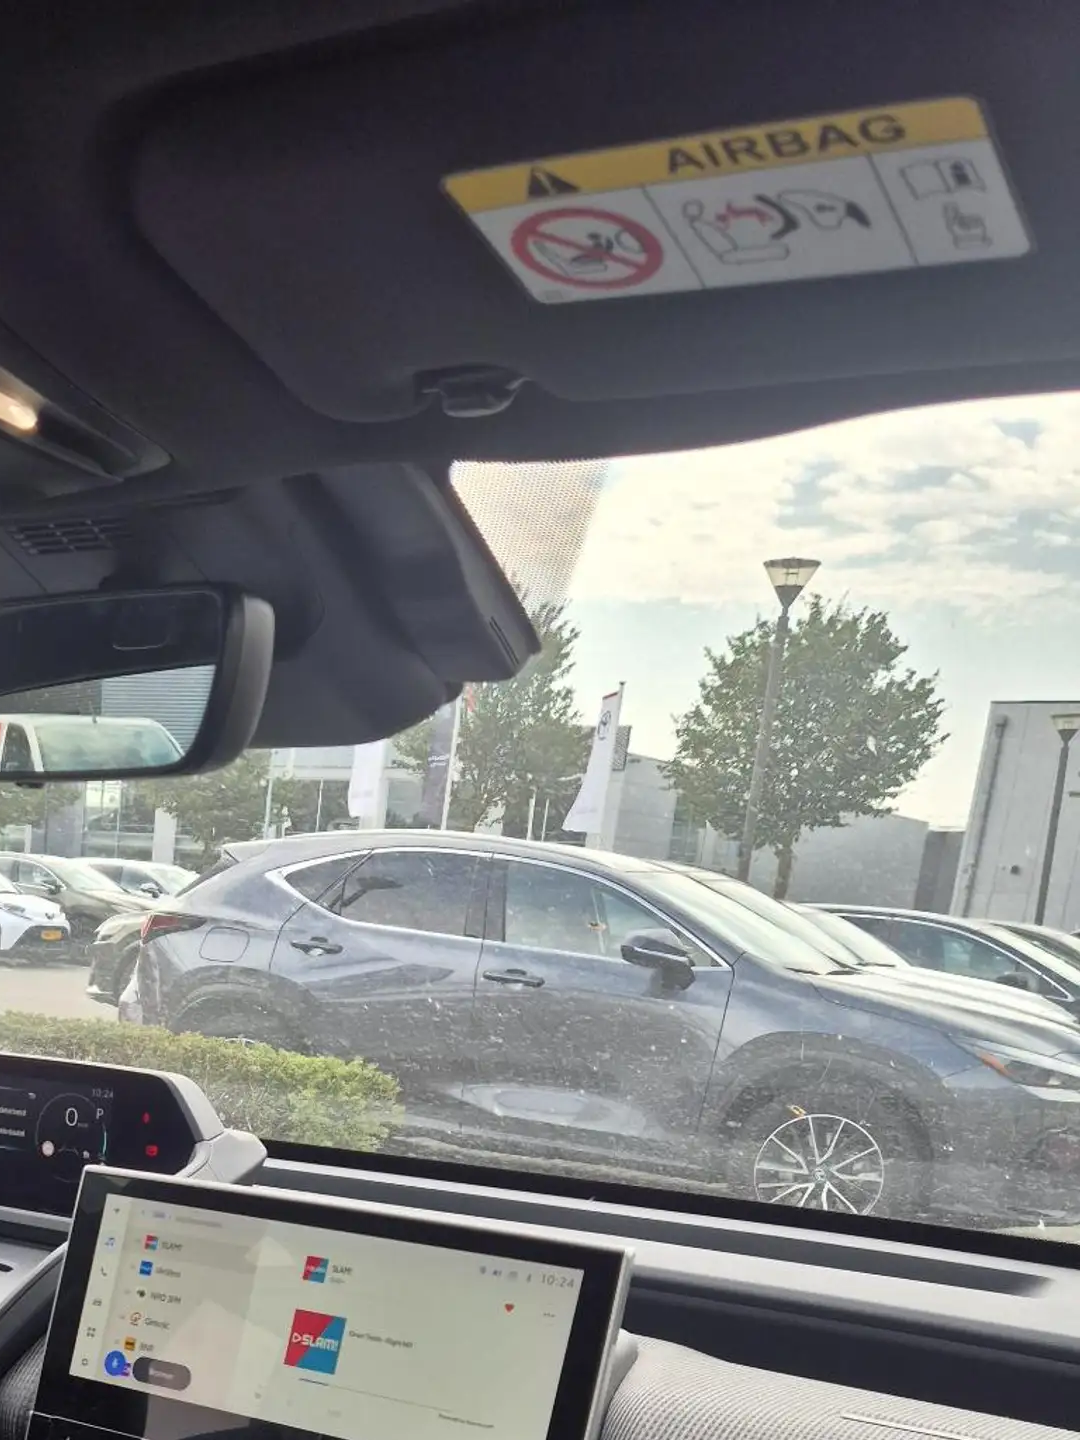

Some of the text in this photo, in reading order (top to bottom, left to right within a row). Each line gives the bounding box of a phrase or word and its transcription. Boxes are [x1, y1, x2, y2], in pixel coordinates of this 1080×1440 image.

[666, 113, 907, 175] AIRBAG
[65, 1107, 79, 1127] 0
[96, 1107, 105, 1120] P
[542, 1273, 576, 1288] 10:24
